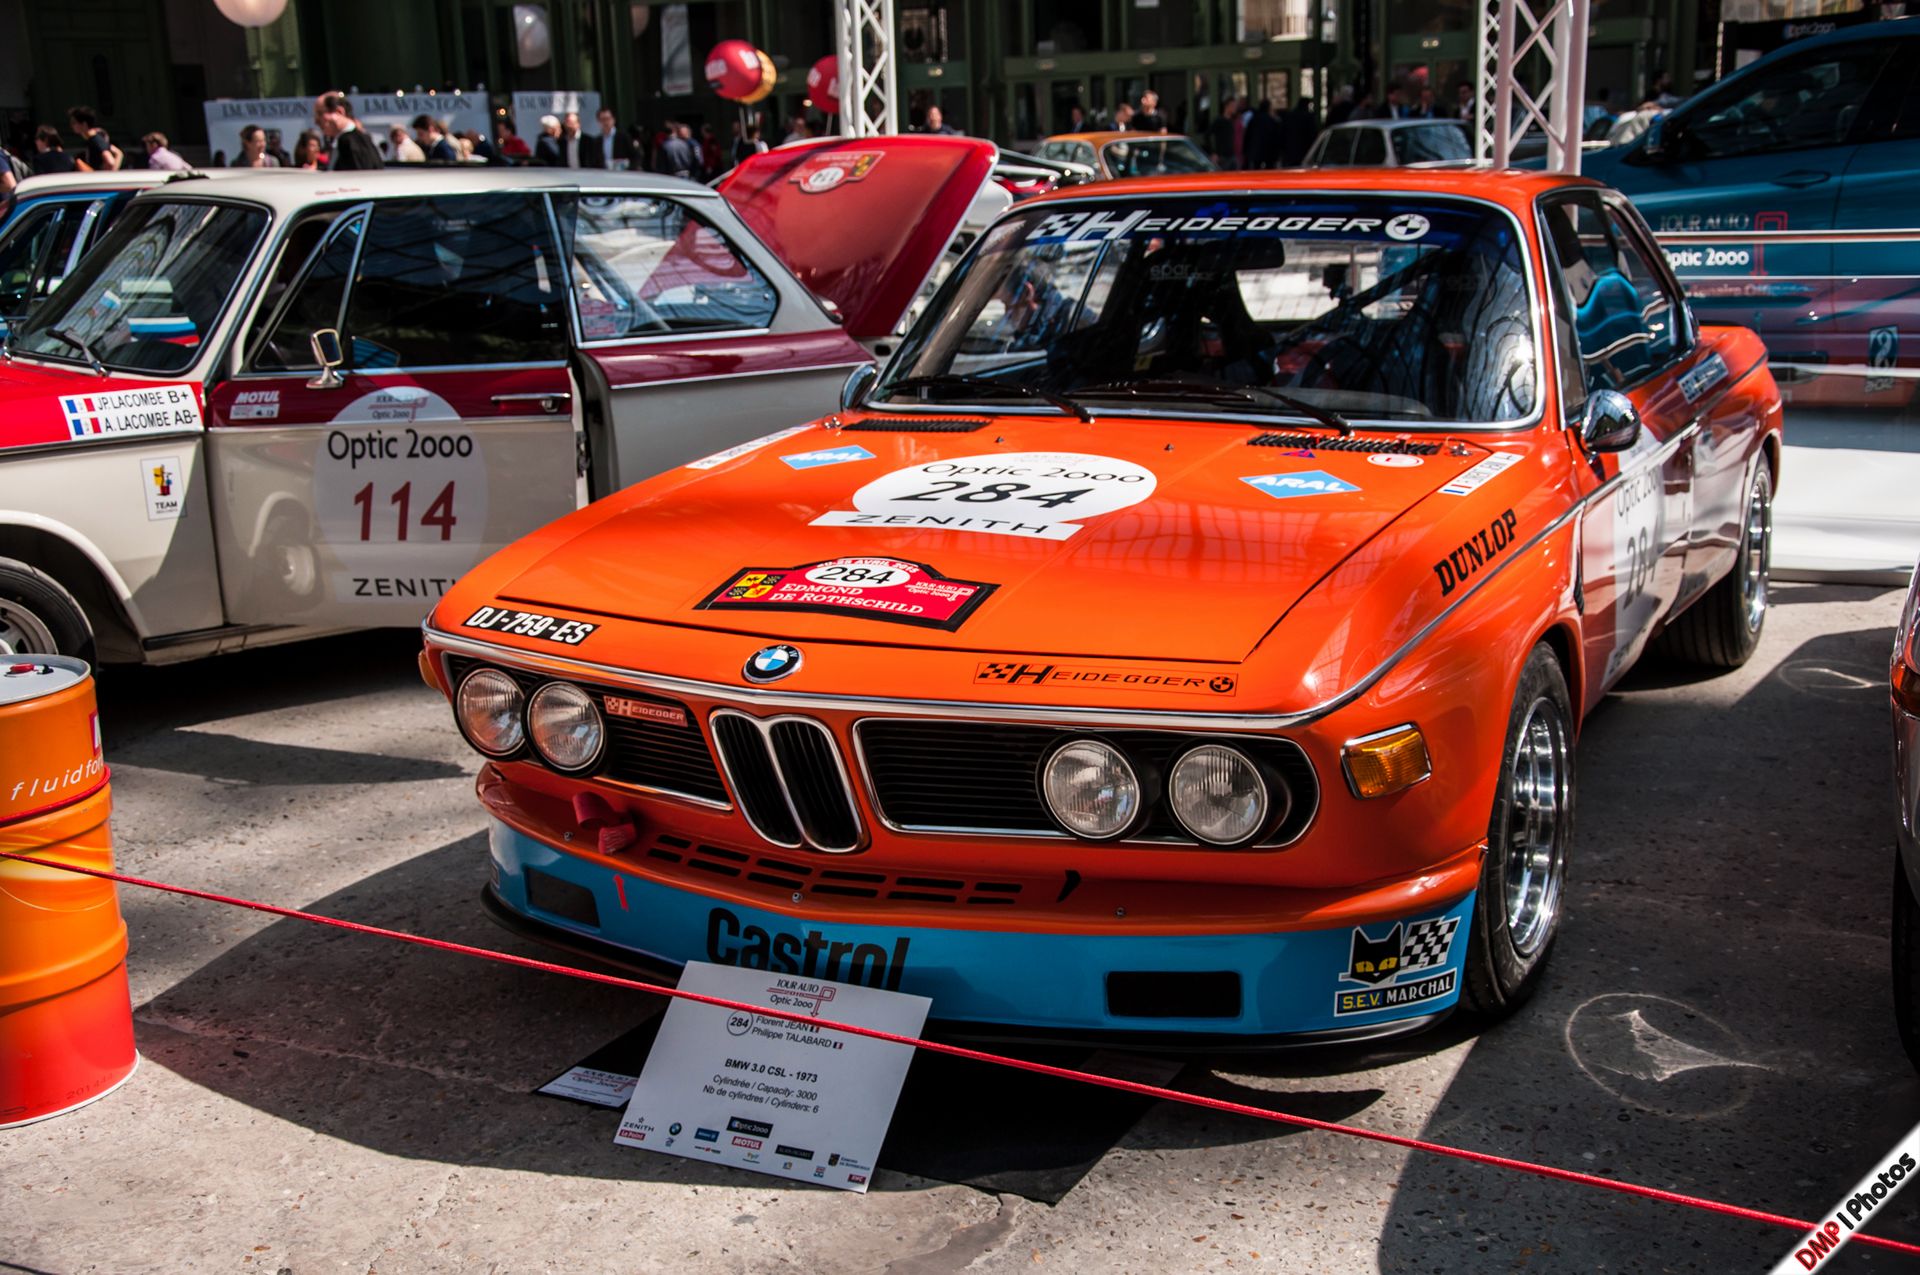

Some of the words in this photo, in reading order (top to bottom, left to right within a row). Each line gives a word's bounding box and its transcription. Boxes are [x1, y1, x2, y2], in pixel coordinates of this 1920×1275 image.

[245, 102, 308, 116] WESTON
[392, 96, 472, 111] WESTON
[1070, 210, 1383, 240] HEIDEGGER
[1706, 248, 1749, 266] 2000
[168, 390, 189, 404] B+
[235, 390, 280, 404] MOTUL
[118, 411, 171, 431] LACOMBE
[174, 410, 198, 425] AB-
[328, 430, 398, 469] Optic
[406, 428, 473, 459] 2000
[922, 464, 1033, 477] Optic
[1040, 467, 1145, 483] 2000
[1250, 475, 1345, 492] ARAL
[155, 501, 178, 509] TEAM
[889, 481, 1096, 509] 284
[354, 481, 457, 541] 114
[846, 514, 1049, 534] ZENITH
[856, 558, 890, 567] AVRIL
[1433, 508, 1518, 597] DUNLOP
[818, 565, 896, 585] 284
[353, 578, 456, 596] ZENIT
[779, 583, 863, 596] EDMOND
[770, 592, 796, 601] DE
[800, 593, 924, 615] ROTHSCHILD
[466, 607, 594, 644] DJ-759-ES
[1007, 664, 1206, 687] HEIDEGGER
[621, 700, 685, 721] HEIDEGGER
[707, 907, 911, 992] Castrol
[777, 979, 798, 990] TOUR
[798, 982, 819, 993] AUTO
[1343, 993, 1381, 1009] S.E.V.
[1387, 976, 1451, 1003] MARCHAL
[770, 994, 792, 1006] Optic
[793, 998, 813, 1008] 2000
[730, 1017, 749, 1028] 284
[756, 1015, 785, 1026] Florent
[785, 1021, 808, 1032] JEAN
[752, 1027, 783, 1039] Philippe
[786, 1032, 832, 1048] TALABARD
[725, 1058, 750, 1070] BMW
[751, 1064, 766, 1073] 3.0
[767, 1066, 787, 1077] CSL
[796, 1071, 818, 1083] 1973
[713, 1074, 751, 1088] Cylindrée
[757, 1082, 794, 1098] Capacity:
[796, 1090, 818, 1101] 3000
[703, 1084, 715, 1094] Nb
[716, 1087, 727, 1096] de
[728, 1091, 764, 1104] cylindres
[812, 1105, 819, 1114] 6
[623, 1121, 655, 1132] ZENITH
[733, 1136, 760, 1149] MOTUL
